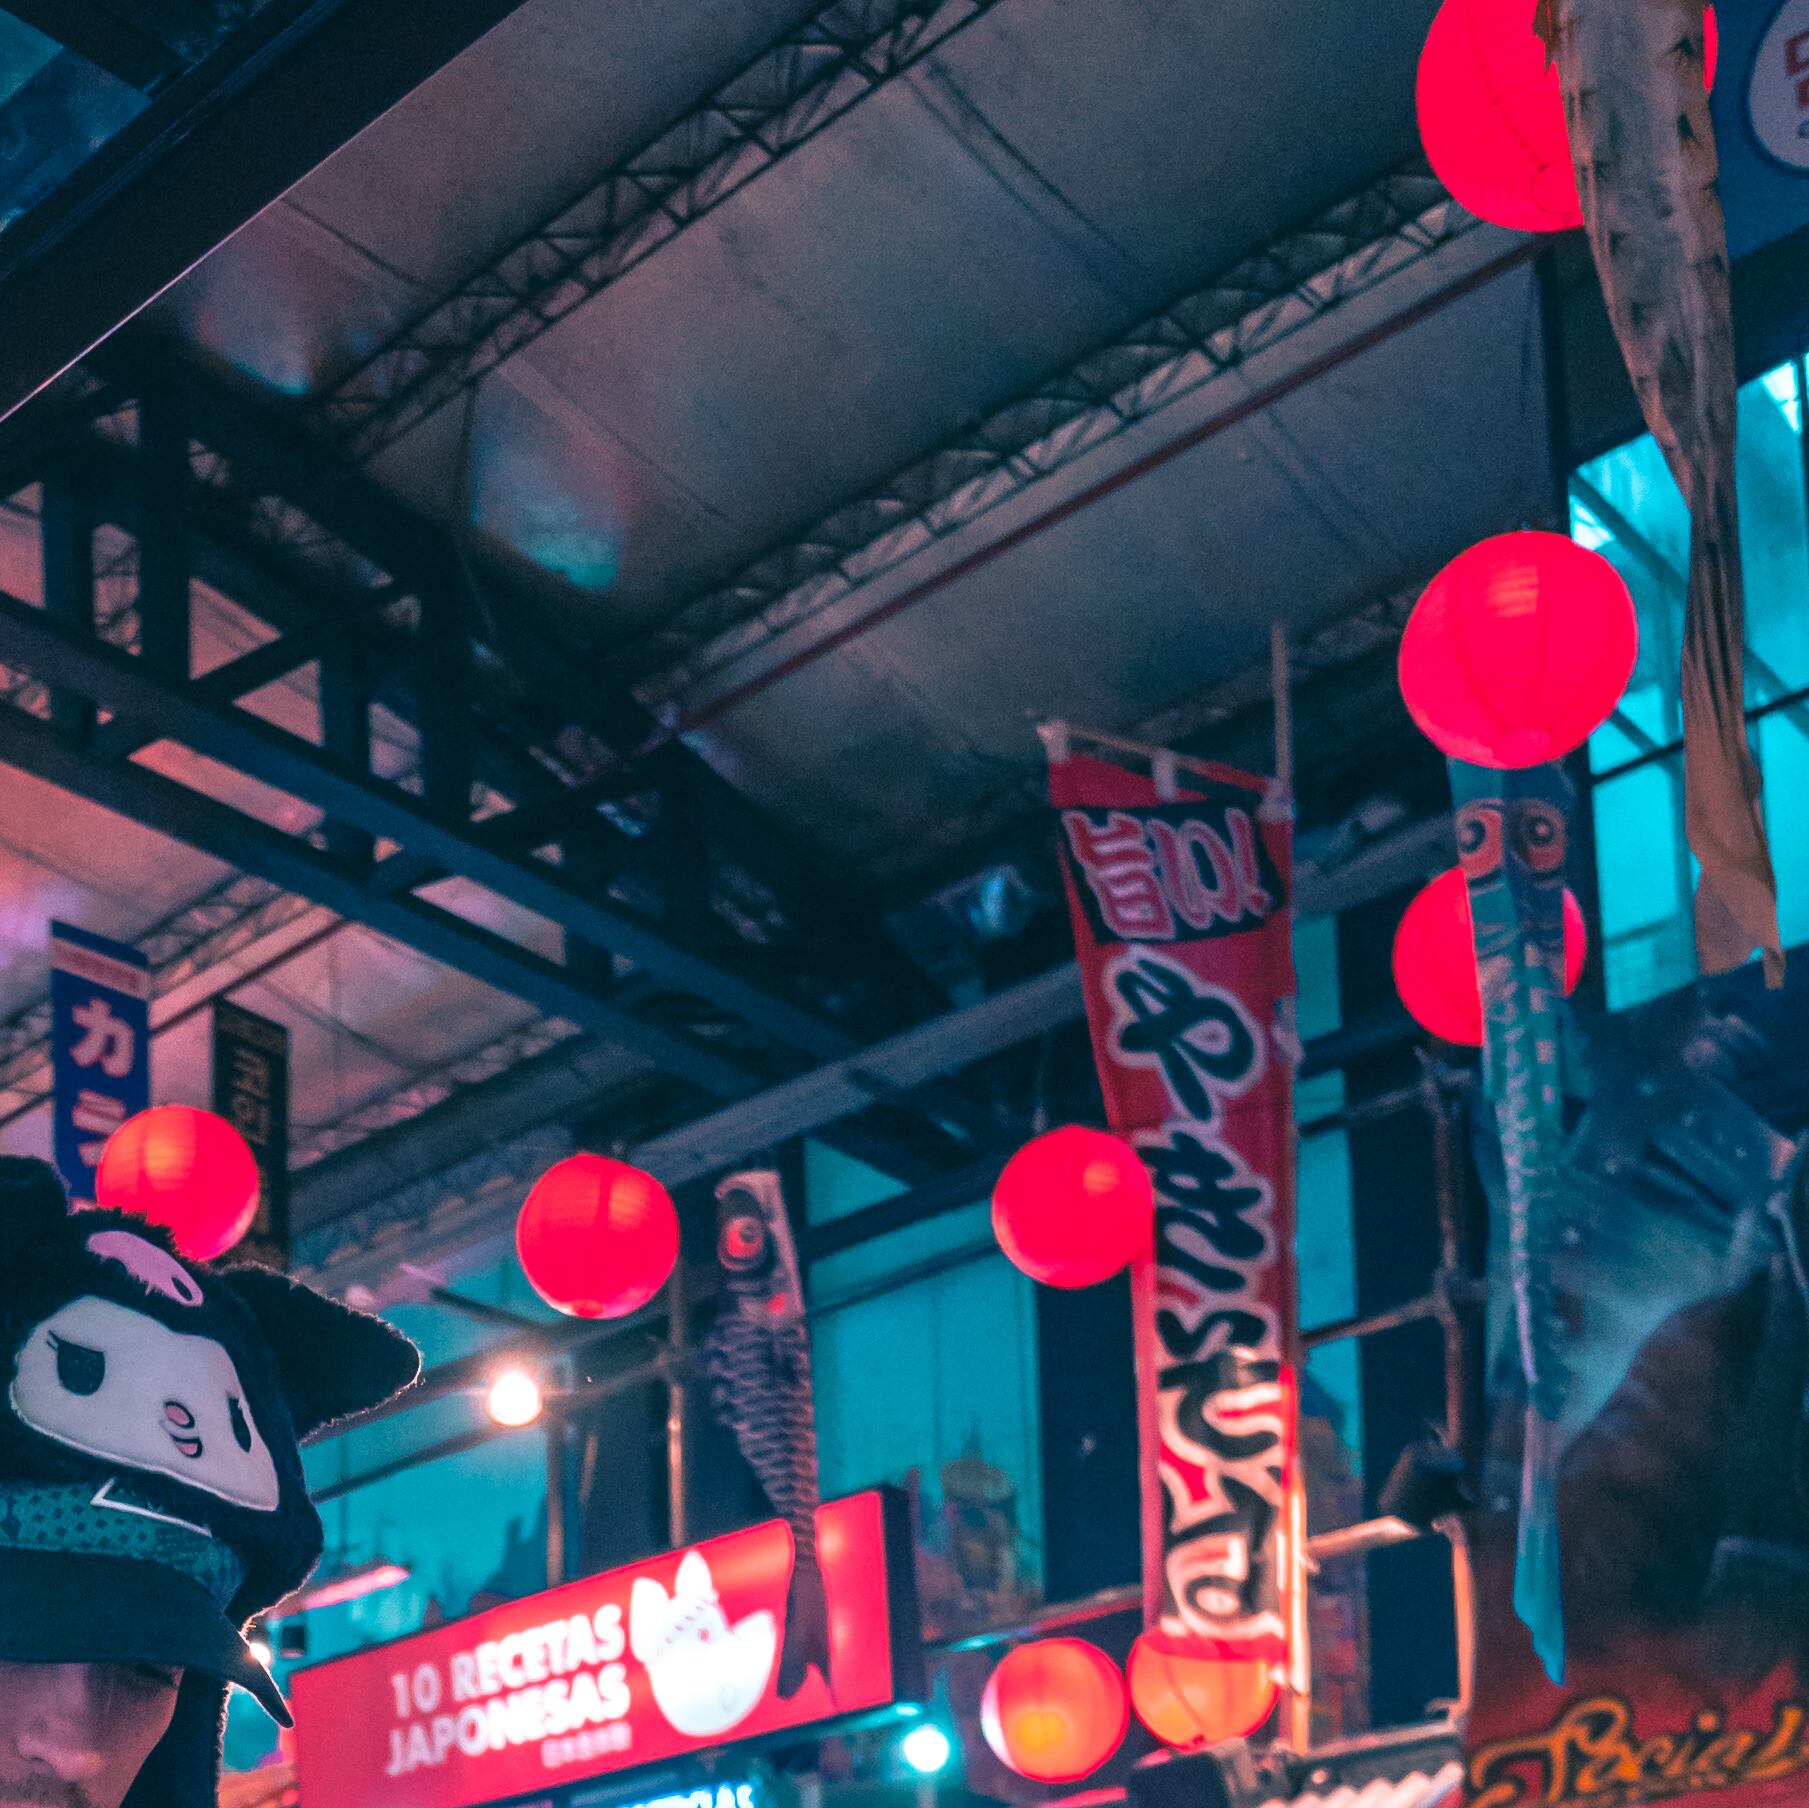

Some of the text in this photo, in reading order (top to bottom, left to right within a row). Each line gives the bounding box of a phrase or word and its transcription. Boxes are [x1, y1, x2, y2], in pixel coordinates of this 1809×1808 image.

[385, 1661, 633, 1777] JAPONESAS
[391, 1603, 626, 1719] 10 RECETAS
